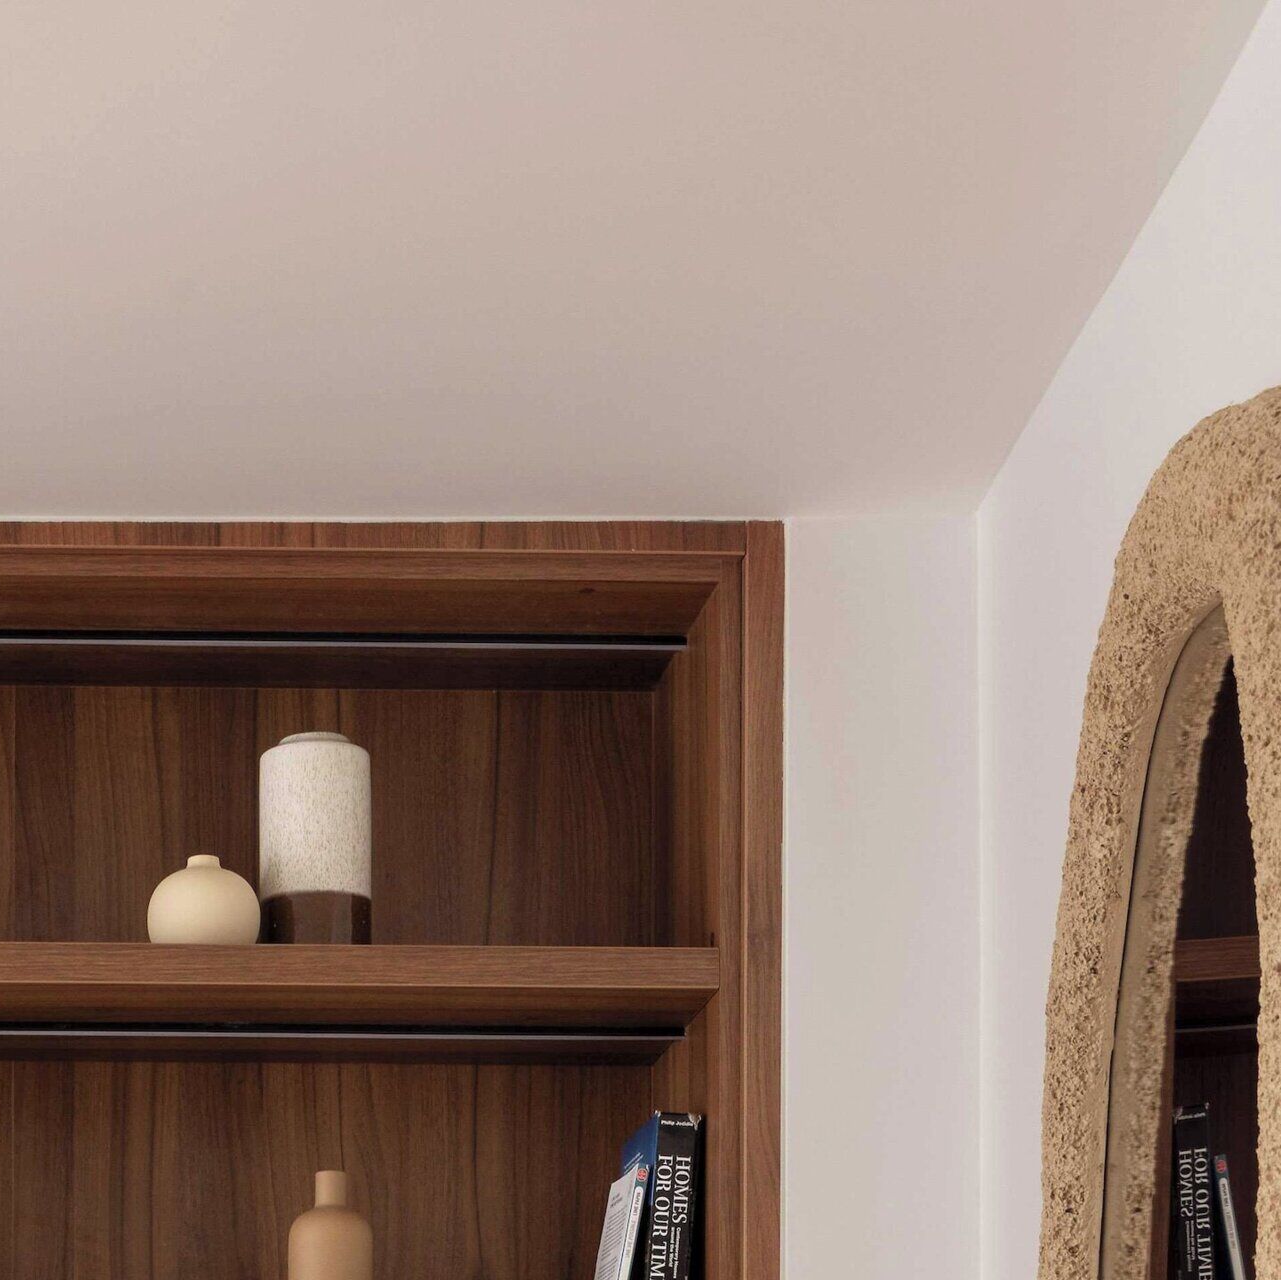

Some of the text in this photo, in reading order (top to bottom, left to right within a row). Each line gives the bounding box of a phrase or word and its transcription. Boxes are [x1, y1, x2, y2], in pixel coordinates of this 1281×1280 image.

[656, 1154, 674, 1193] FOR
[672, 1155, 691, 1224] HOMES
[653, 1195, 670, 1237] OUR
